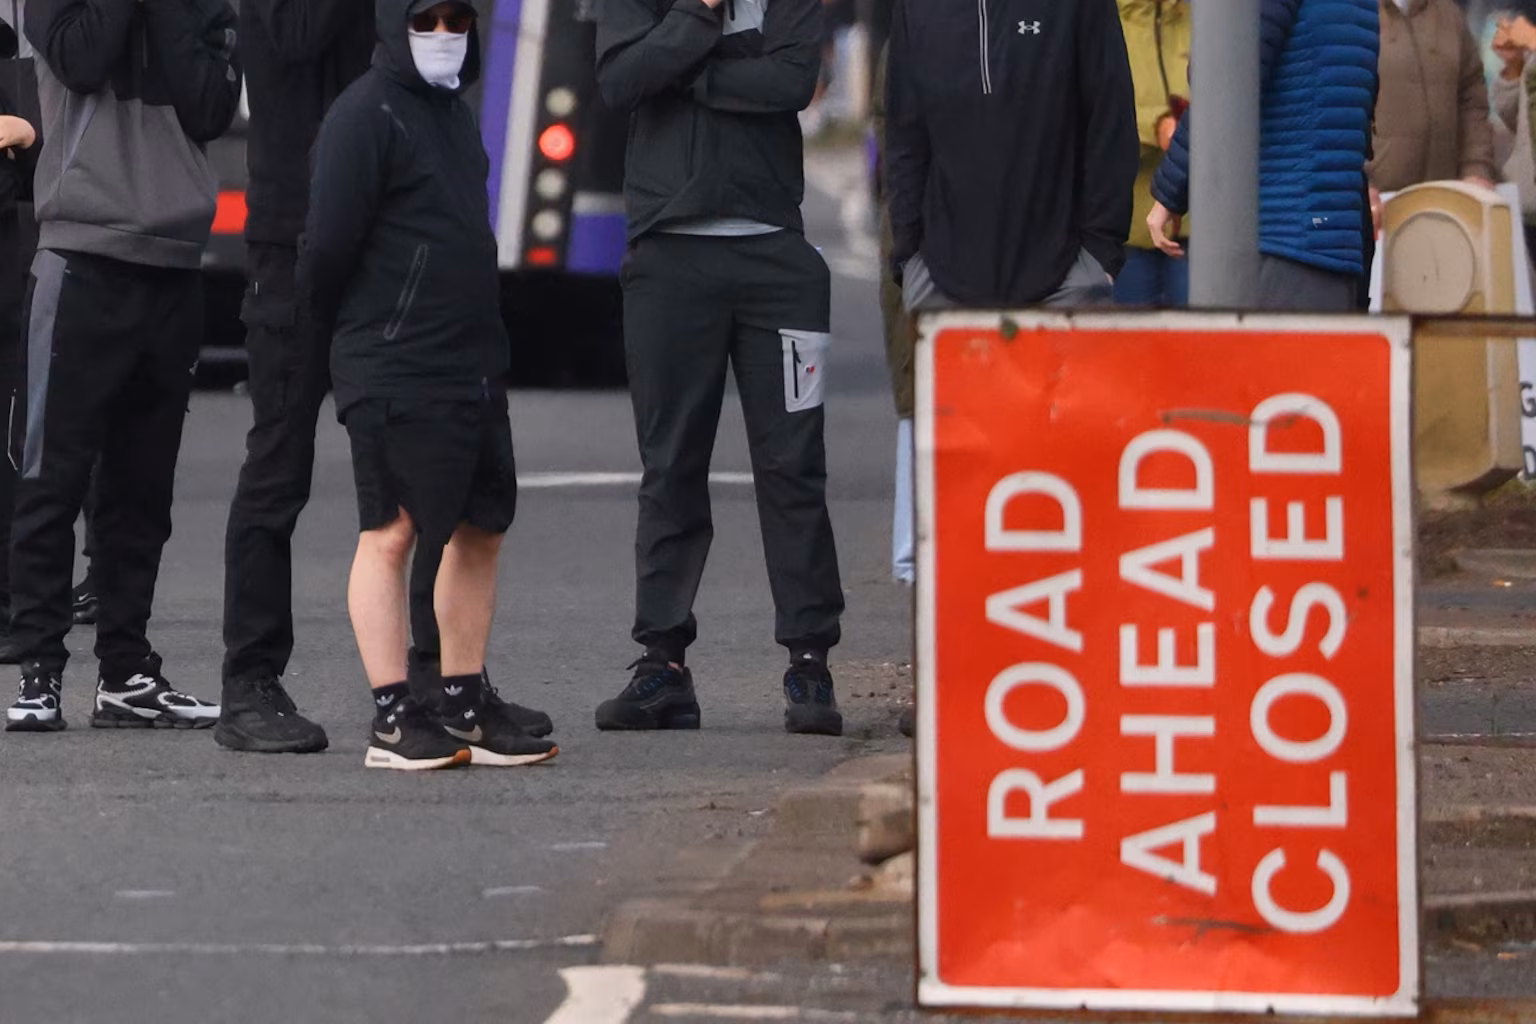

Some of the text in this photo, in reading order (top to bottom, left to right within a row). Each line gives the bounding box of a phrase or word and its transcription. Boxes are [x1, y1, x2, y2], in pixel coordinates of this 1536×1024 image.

[984, 471, 1085, 839] ROAD
[1118, 429, 1216, 896] AHEAD
[1249, 393, 1350, 934] CLOSED
